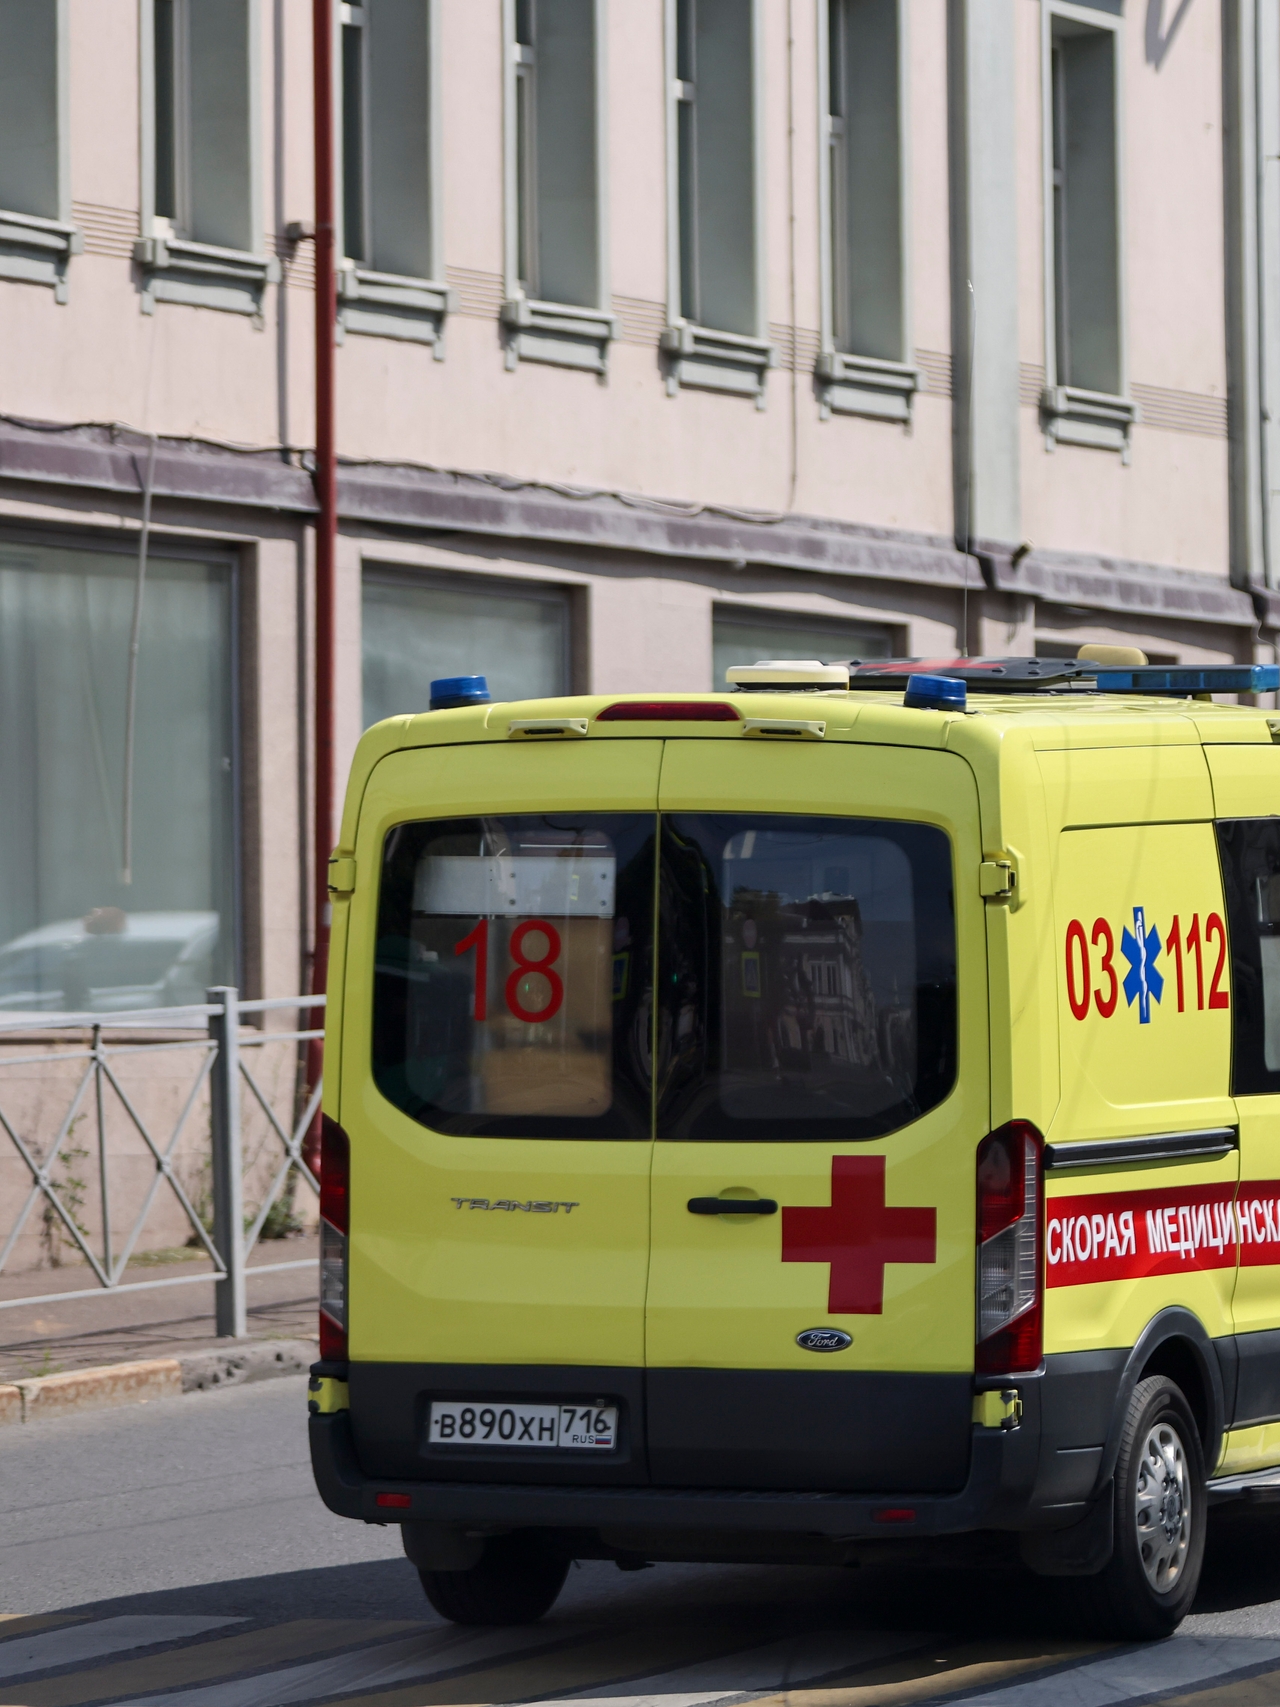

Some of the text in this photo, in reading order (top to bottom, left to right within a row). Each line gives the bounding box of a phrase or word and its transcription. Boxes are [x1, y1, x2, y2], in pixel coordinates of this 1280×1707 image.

[454, 919, 564, 1023] 18
[1065, 912, 1229, 1021] 03 112
[451, 1197, 580, 1213] TRANSIT
[1046, 1211, 1136, 1265] СКОРАЯ
[807, 1333, 839, 1347] Ford
[562, 1408, 609, 1434] 716
[572, 1434, 595, 1444] RUS
